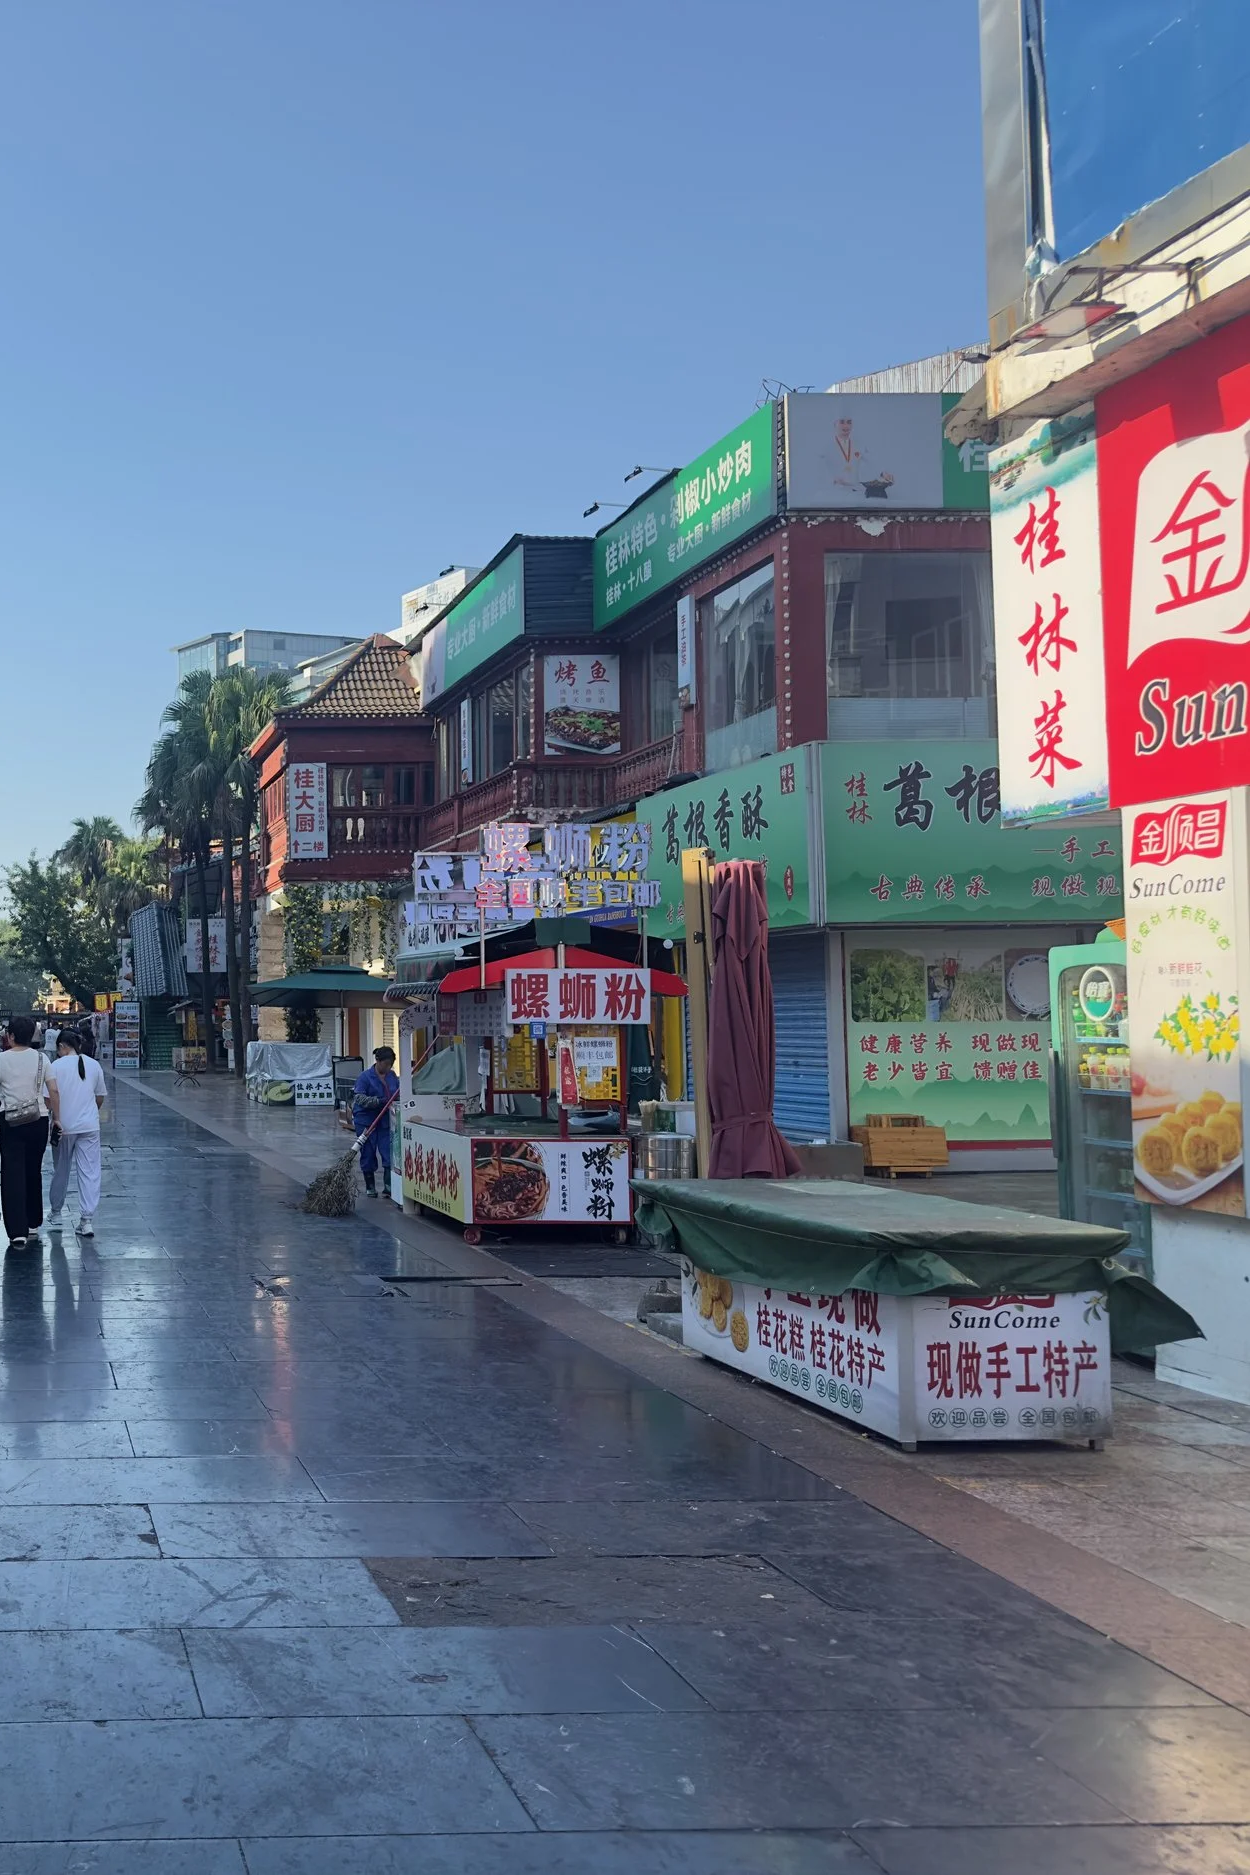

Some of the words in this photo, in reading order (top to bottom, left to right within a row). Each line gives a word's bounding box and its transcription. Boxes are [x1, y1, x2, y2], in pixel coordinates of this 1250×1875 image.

[1012, 486, 1083, 788] 桂林菜
[554, 660, 610, 687] 烤鱼
[294, 769, 315, 833] 桂大厨
[845, 774, 873, 824] 桂林
[662, 785, 769, 866] 葛根香酥
[302, 841, 325, 852] 二楼
[474, 878, 661, 908] 全国顺丰包邮
[870, 876, 991, 900] 古典传承
[1129, 874, 1226, 899] SunCome
[511, 972, 646, 1021] 螺蛳粉
[860, 1032, 953, 1055] 健康营养
[971, 1033, 1053, 1053] 现做现
[861, 1061, 954, 1081] 老少皆宜
[764, 1287, 882, 1337] 现做
[949, 1311, 1060, 1329] SunCome
[757, 1301, 806, 1361] 桂花糕
[810, 1320, 886, 1390] 桂花特产
[769, 1355, 811, 1391] 欢迎品尝
[926, 1340, 1098, 1399] 现做手工特产
[928, 1408, 1009, 1429] 欢迎品尝
[1018, 1407, 1100, 1428] 全国包邮
